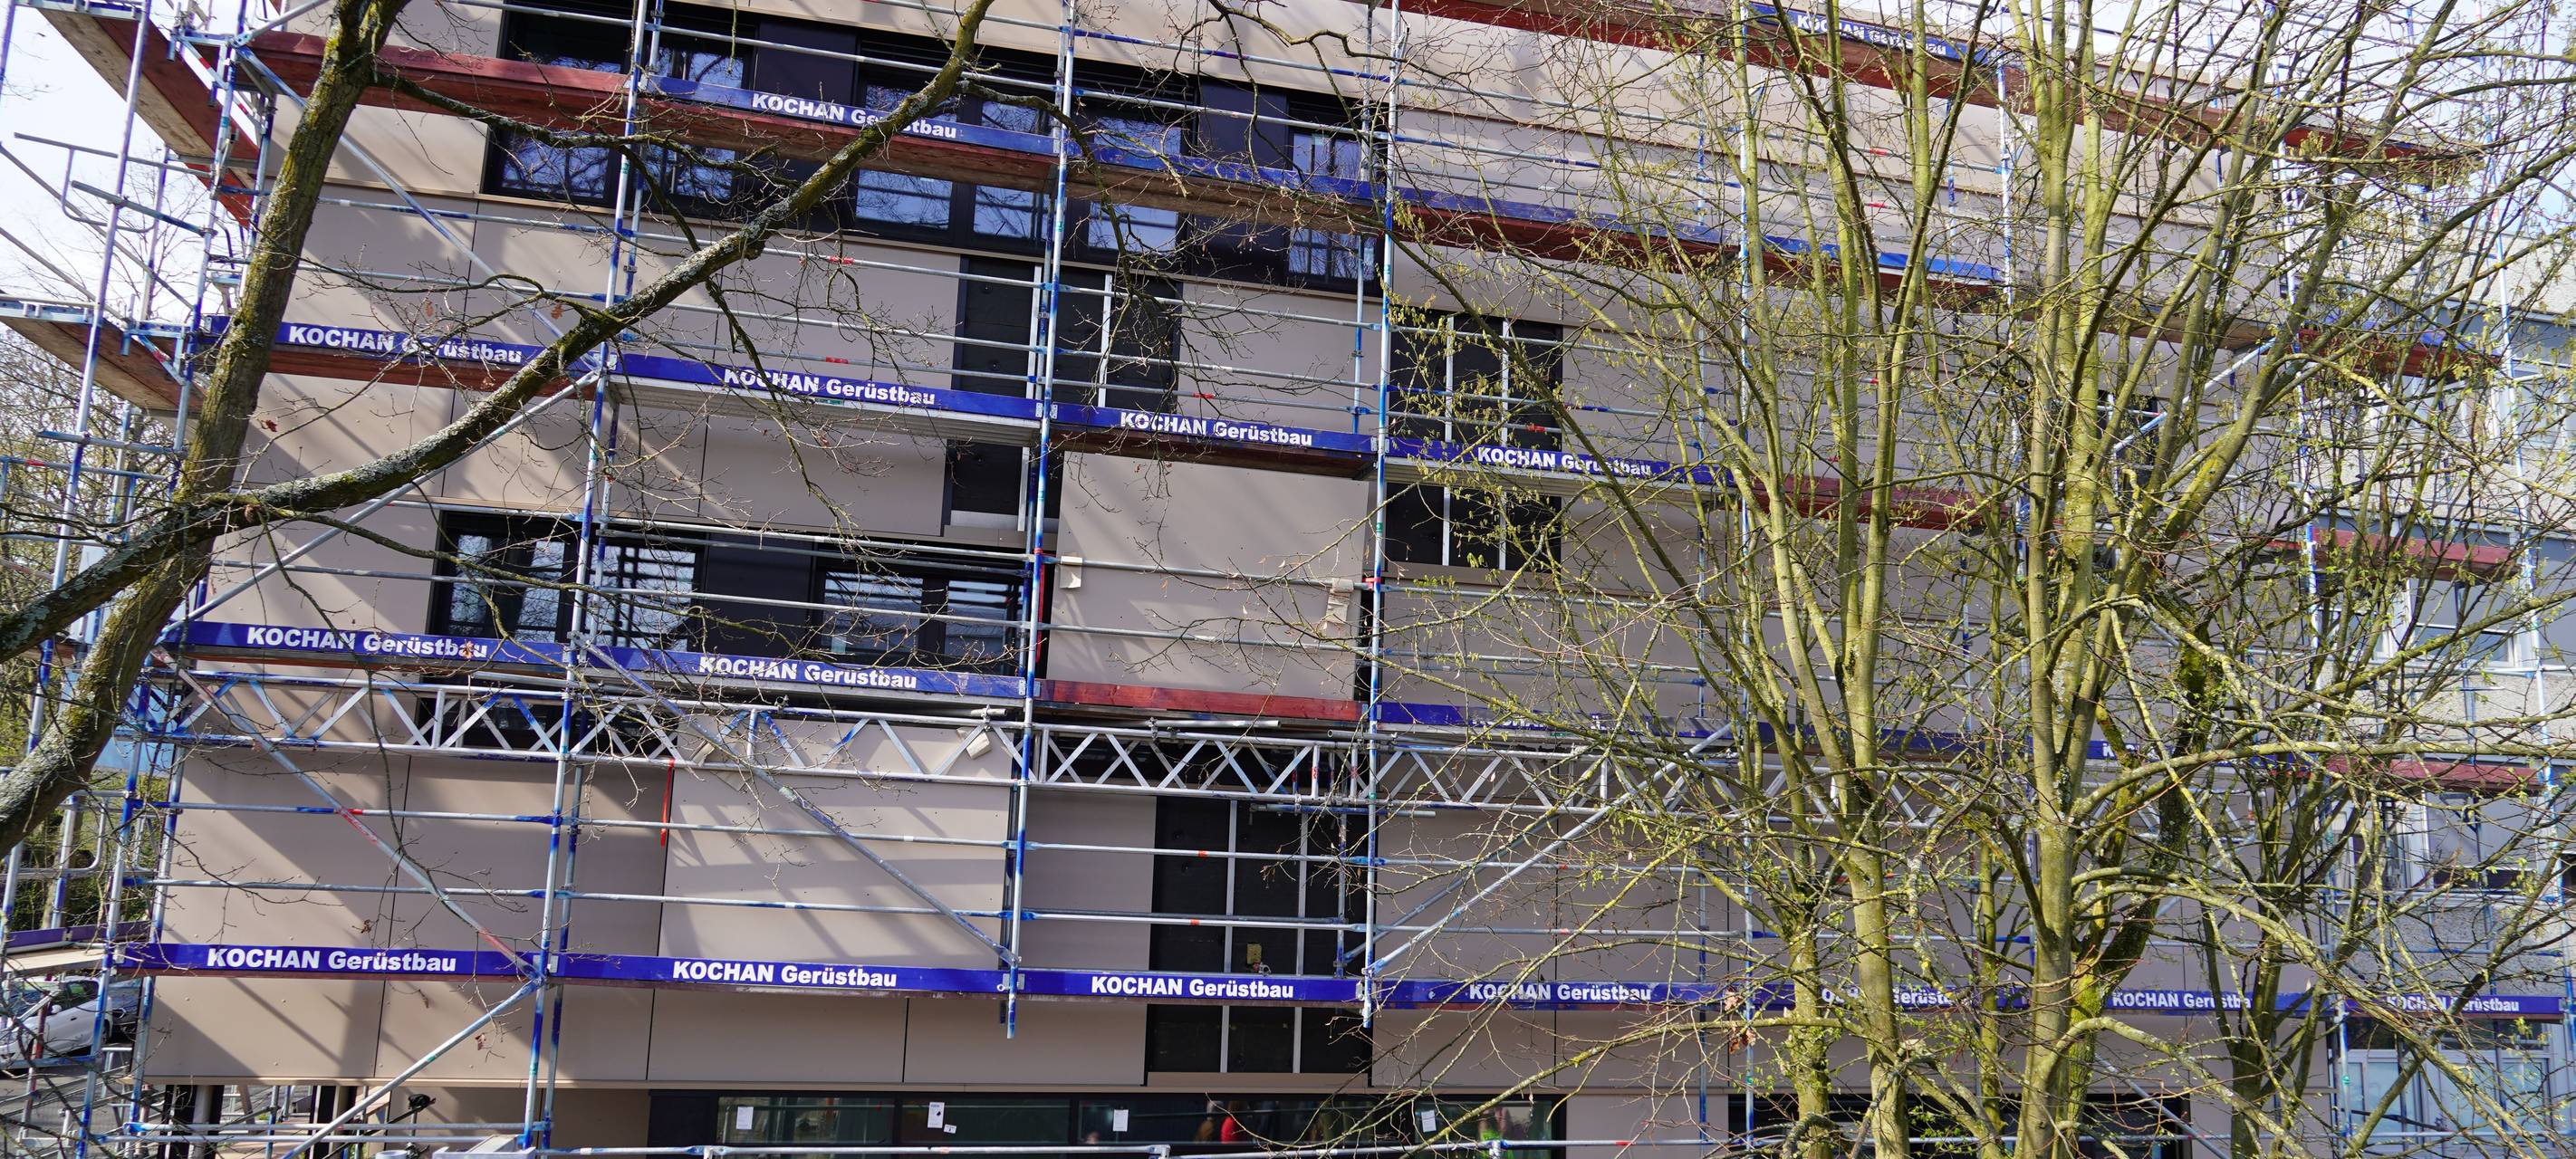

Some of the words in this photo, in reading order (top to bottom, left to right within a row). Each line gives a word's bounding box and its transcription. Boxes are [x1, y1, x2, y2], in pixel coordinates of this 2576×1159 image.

[1797, 14, 1865, 40] KOCAN
[1869, 30, 1946, 55] Gerüsau
[751, 93, 844, 121] KOCHAN
[851, 110, 956, 139] Getbau
[289, 326, 394, 351] KOCHAN
[724, 368, 819, 393] KOCHAN
[826, 378, 936, 406] Gerüstbau
[1120, 412, 1206, 436] KOCHAN
[1213, 421, 1312, 445] Gerüstbau
[1477, 446, 1556, 467] KOCHAN
[246, 627, 356, 649] KOCHAN
[363, 634, 488, 658] Gerüstbau
[699, 656, 797, 680] KOCHAN
[207, 948, 320, 969] KOCHAN
[327, 951, 457, 972] Gerüstbau
[672, 961, 774, 982] KOCHAN
[781, 963, 897, 987] Gerüstbau
[1091, 976, 1183, 995] KOCHAN
[1189, 979, 1293, 999] Gerüstbau
[1557, 983, 1652, 1001] Gerüstbau
[1892, 987, 1966, 1005] erüst
[2112, 992, 2179, 1008] KOCHAN
[2183, 992, 2253, 1009] Gerstba
[2450, 997, 2520, 1011] erüstbau
